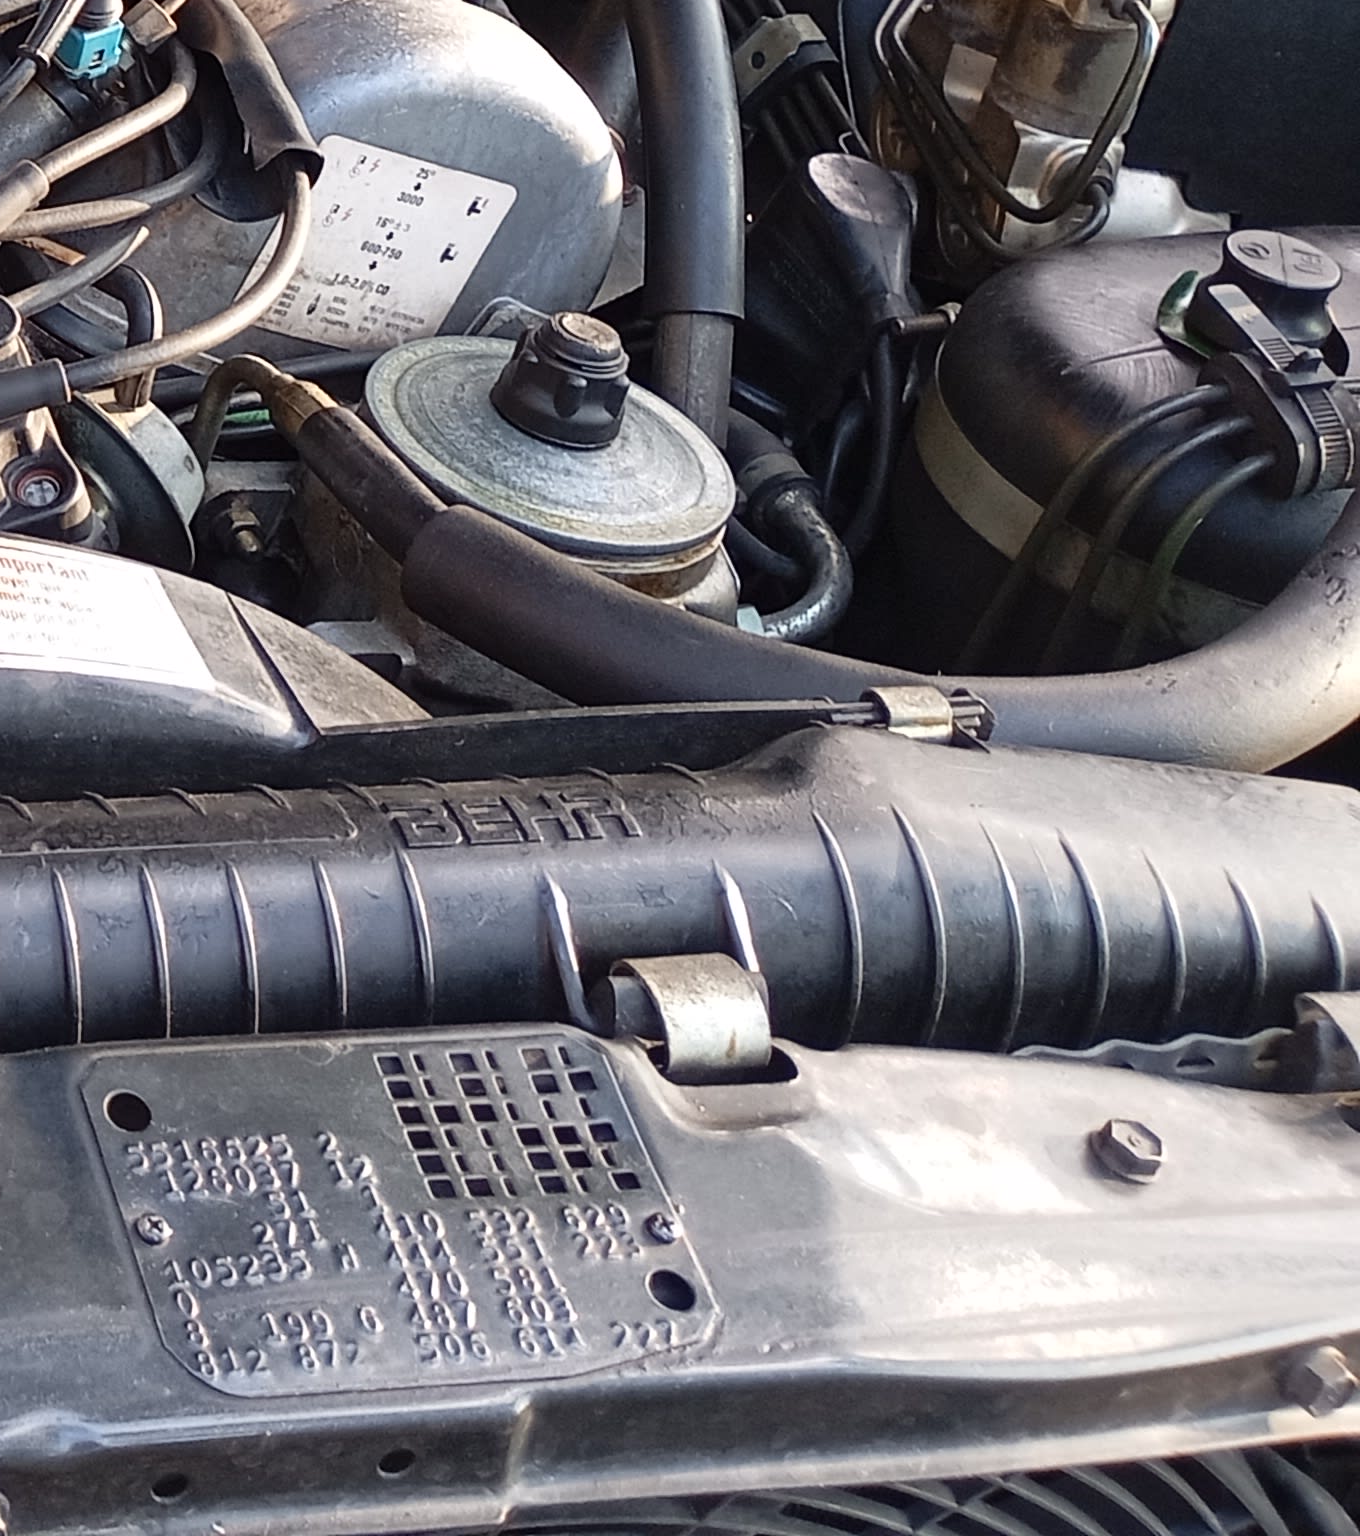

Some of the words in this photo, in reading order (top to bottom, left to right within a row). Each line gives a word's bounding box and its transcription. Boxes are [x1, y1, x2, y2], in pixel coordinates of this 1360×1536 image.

[397, 191, 424, 207] 3000
[381, 792, 643, 849] BEHR
[316, 1130, 342, 1161] 2
[260, 1309, 334, 1346] 199
